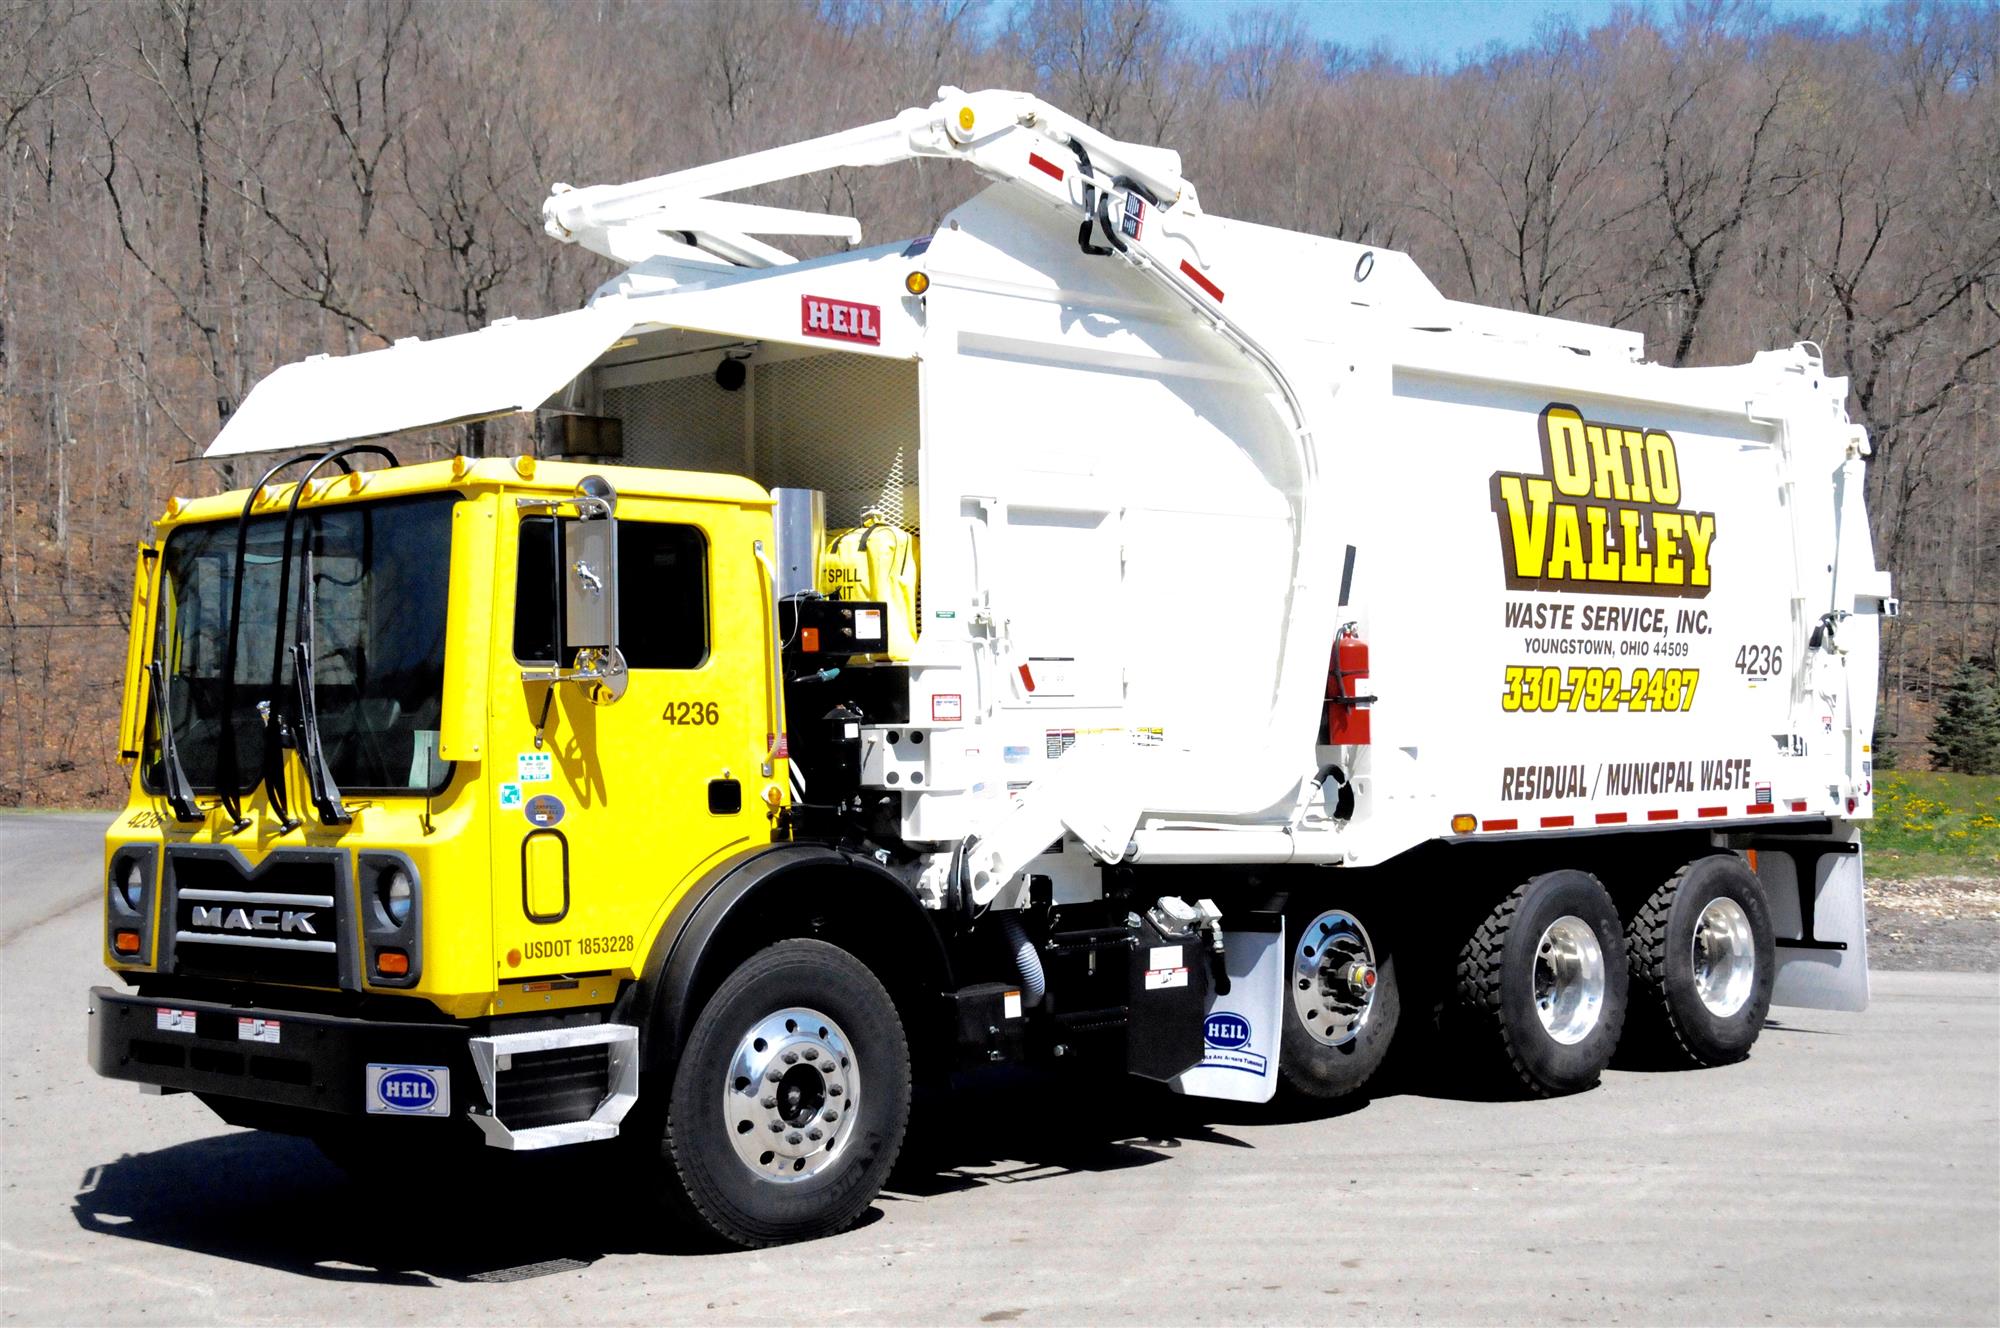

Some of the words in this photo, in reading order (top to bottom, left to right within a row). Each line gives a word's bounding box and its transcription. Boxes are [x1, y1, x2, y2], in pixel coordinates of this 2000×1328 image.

[808, 301, 877, 337] HEIL
[1545, 405, 1682, 507] OHIO
[1499, 474, 1716, 588] VALLEY
[828, 568, 862, 583] SPILL
[1505, 601, 1575, 630] WASTE
[1581, 605, 1668, 638] SERVICE,
[1676, 609, 1713, 634] INC.
[1524, 638, 1615, 658] YOUNGSTOWN,
[1620, 640, 1649, 656] OHIO
[1653, 642, 1689, 657] 44509
[1734, 644, 1783, 675] 4236
[1502, 665, 1700, 712] 330-792-2487
[662, 702, 719, 725] 4236
[1501, 763, 1587, 801] RESIDUAL
[1591, 763, 1602, 800] /
[1606, 760, 1695, 797] MUNICIPAL
[1700, 758, 1752, 791] WASTE
[192, 906, 317, 934] MACK
[524, 939, 572, 960] USDOT
[577, 935, 634, 955] 1853228
[1208, 1023, 1246, 1039] HEIL
[386, 1081, 432, 1098] HEIL
